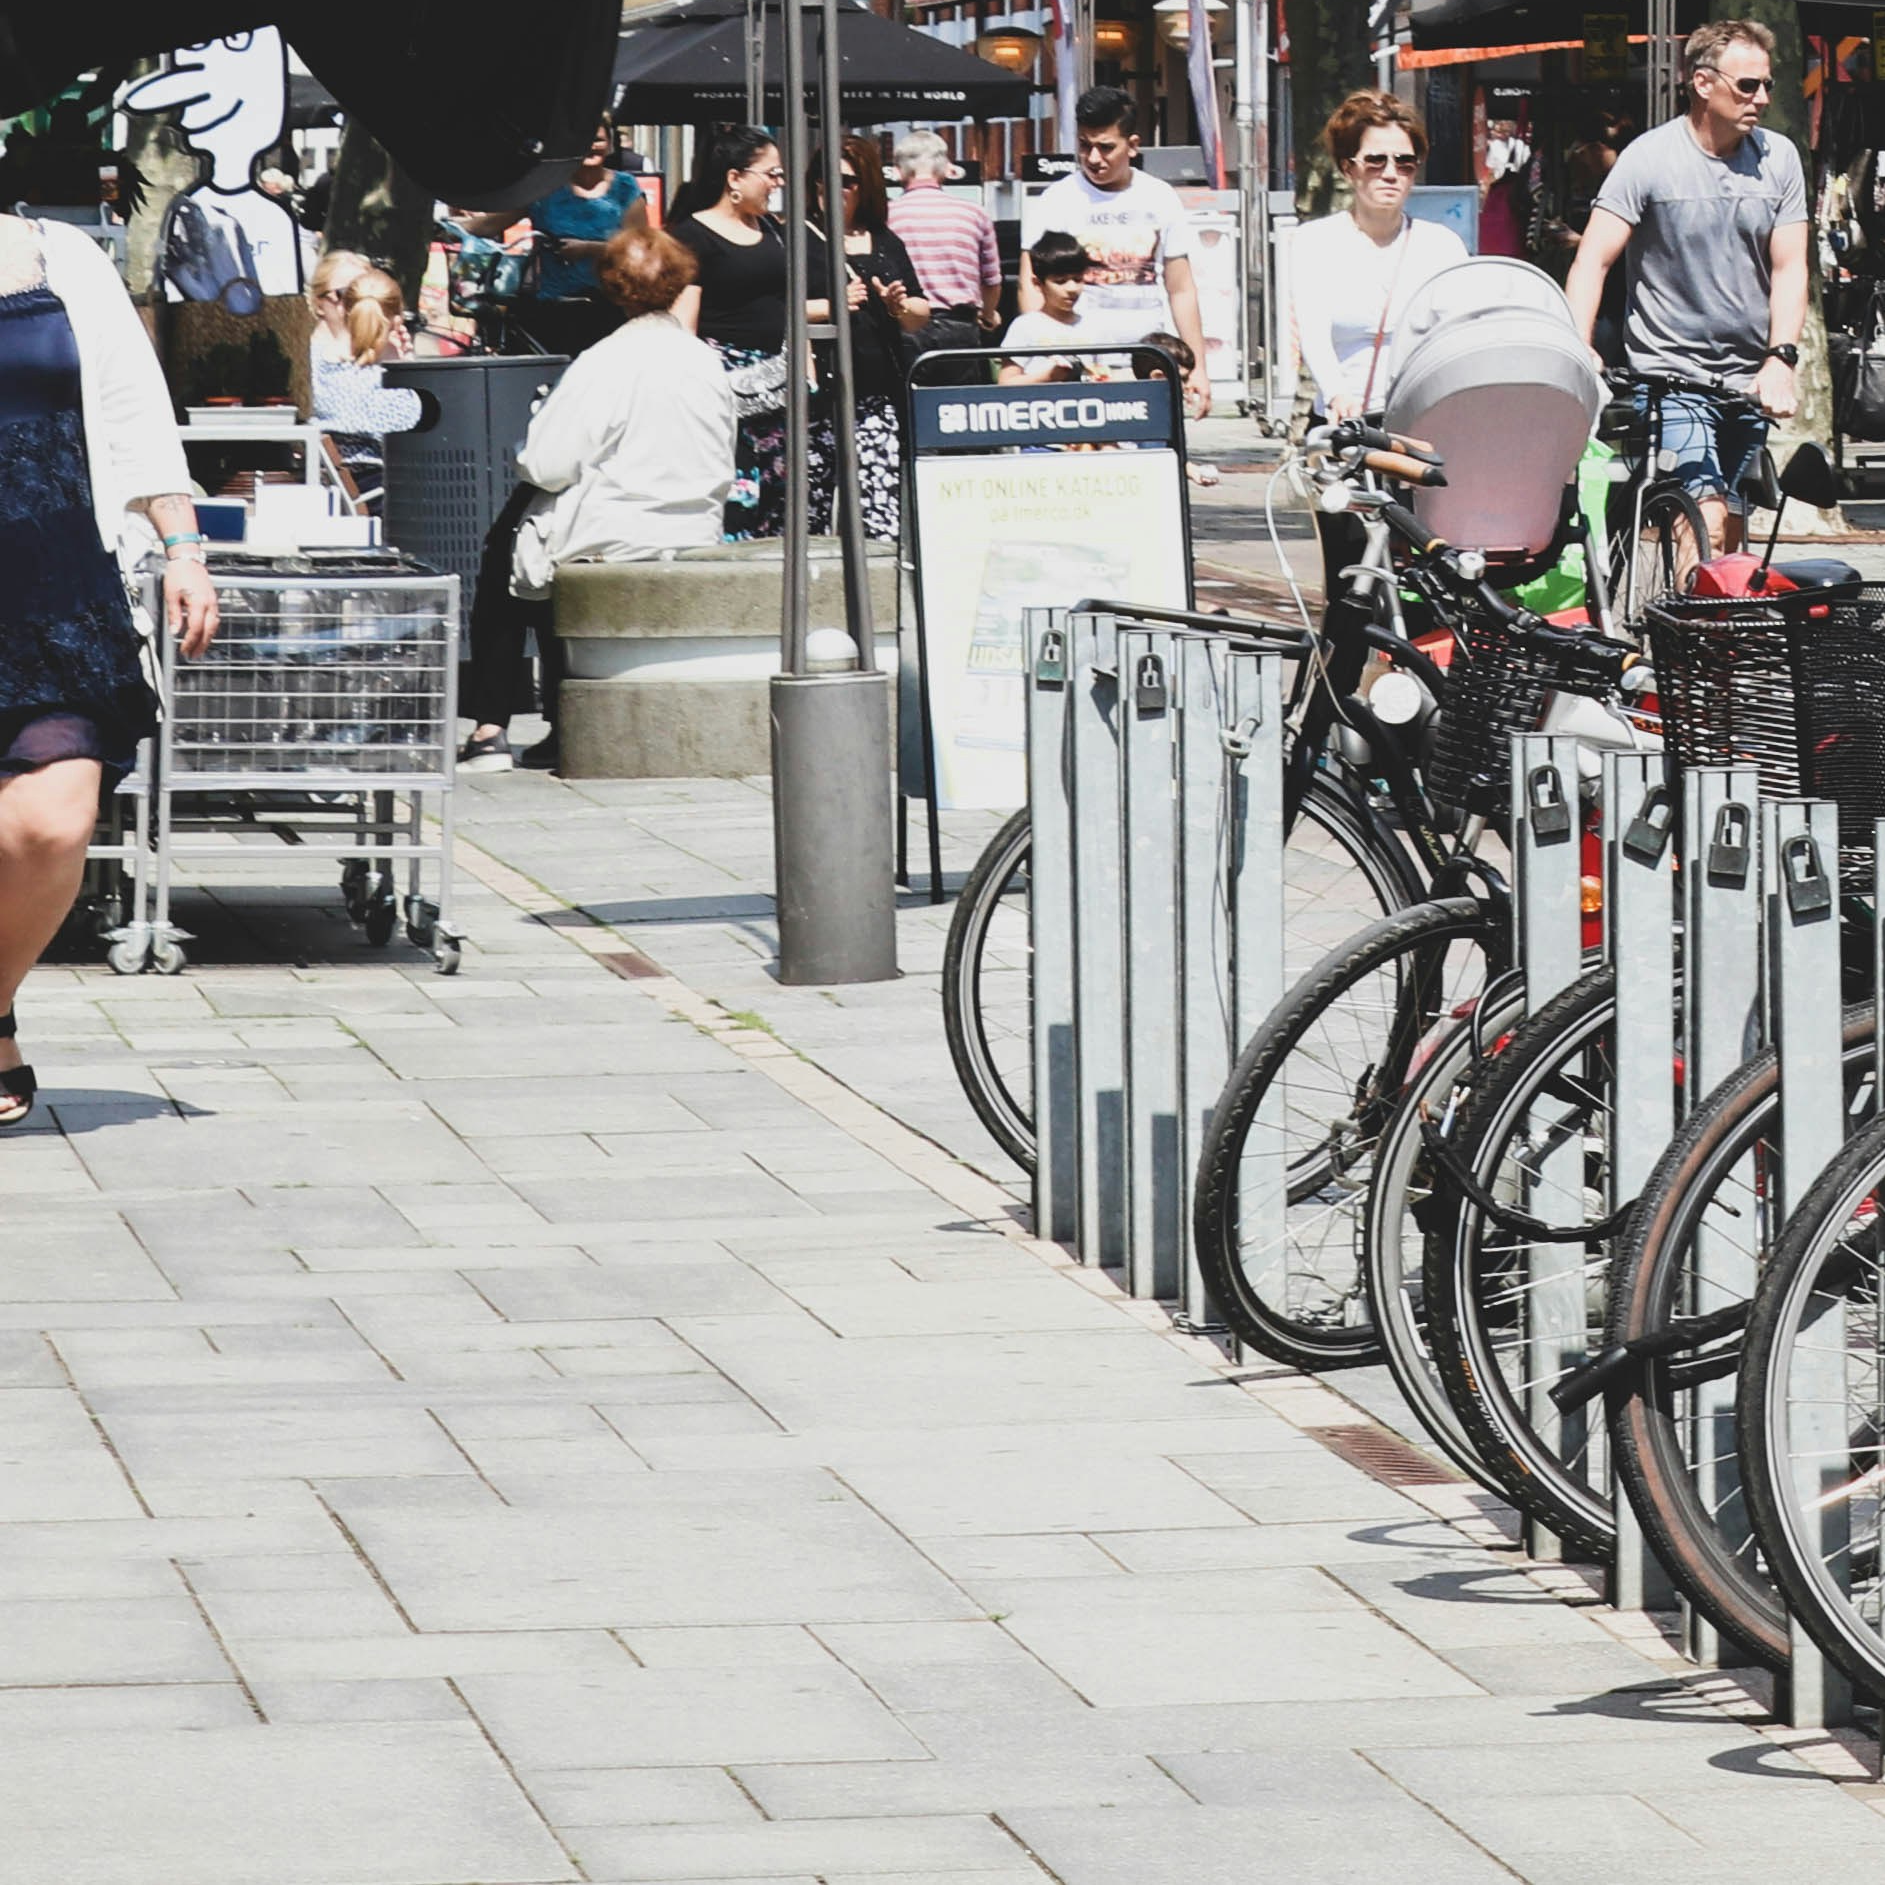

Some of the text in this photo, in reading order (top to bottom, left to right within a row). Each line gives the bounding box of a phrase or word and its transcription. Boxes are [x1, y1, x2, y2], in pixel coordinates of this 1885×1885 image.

[923, 90, 967, 102] WORLD
[970, 397, 1106, 432] IMERCO
[939, 474, 1141, 501] NYT ONLINE KATALOG
